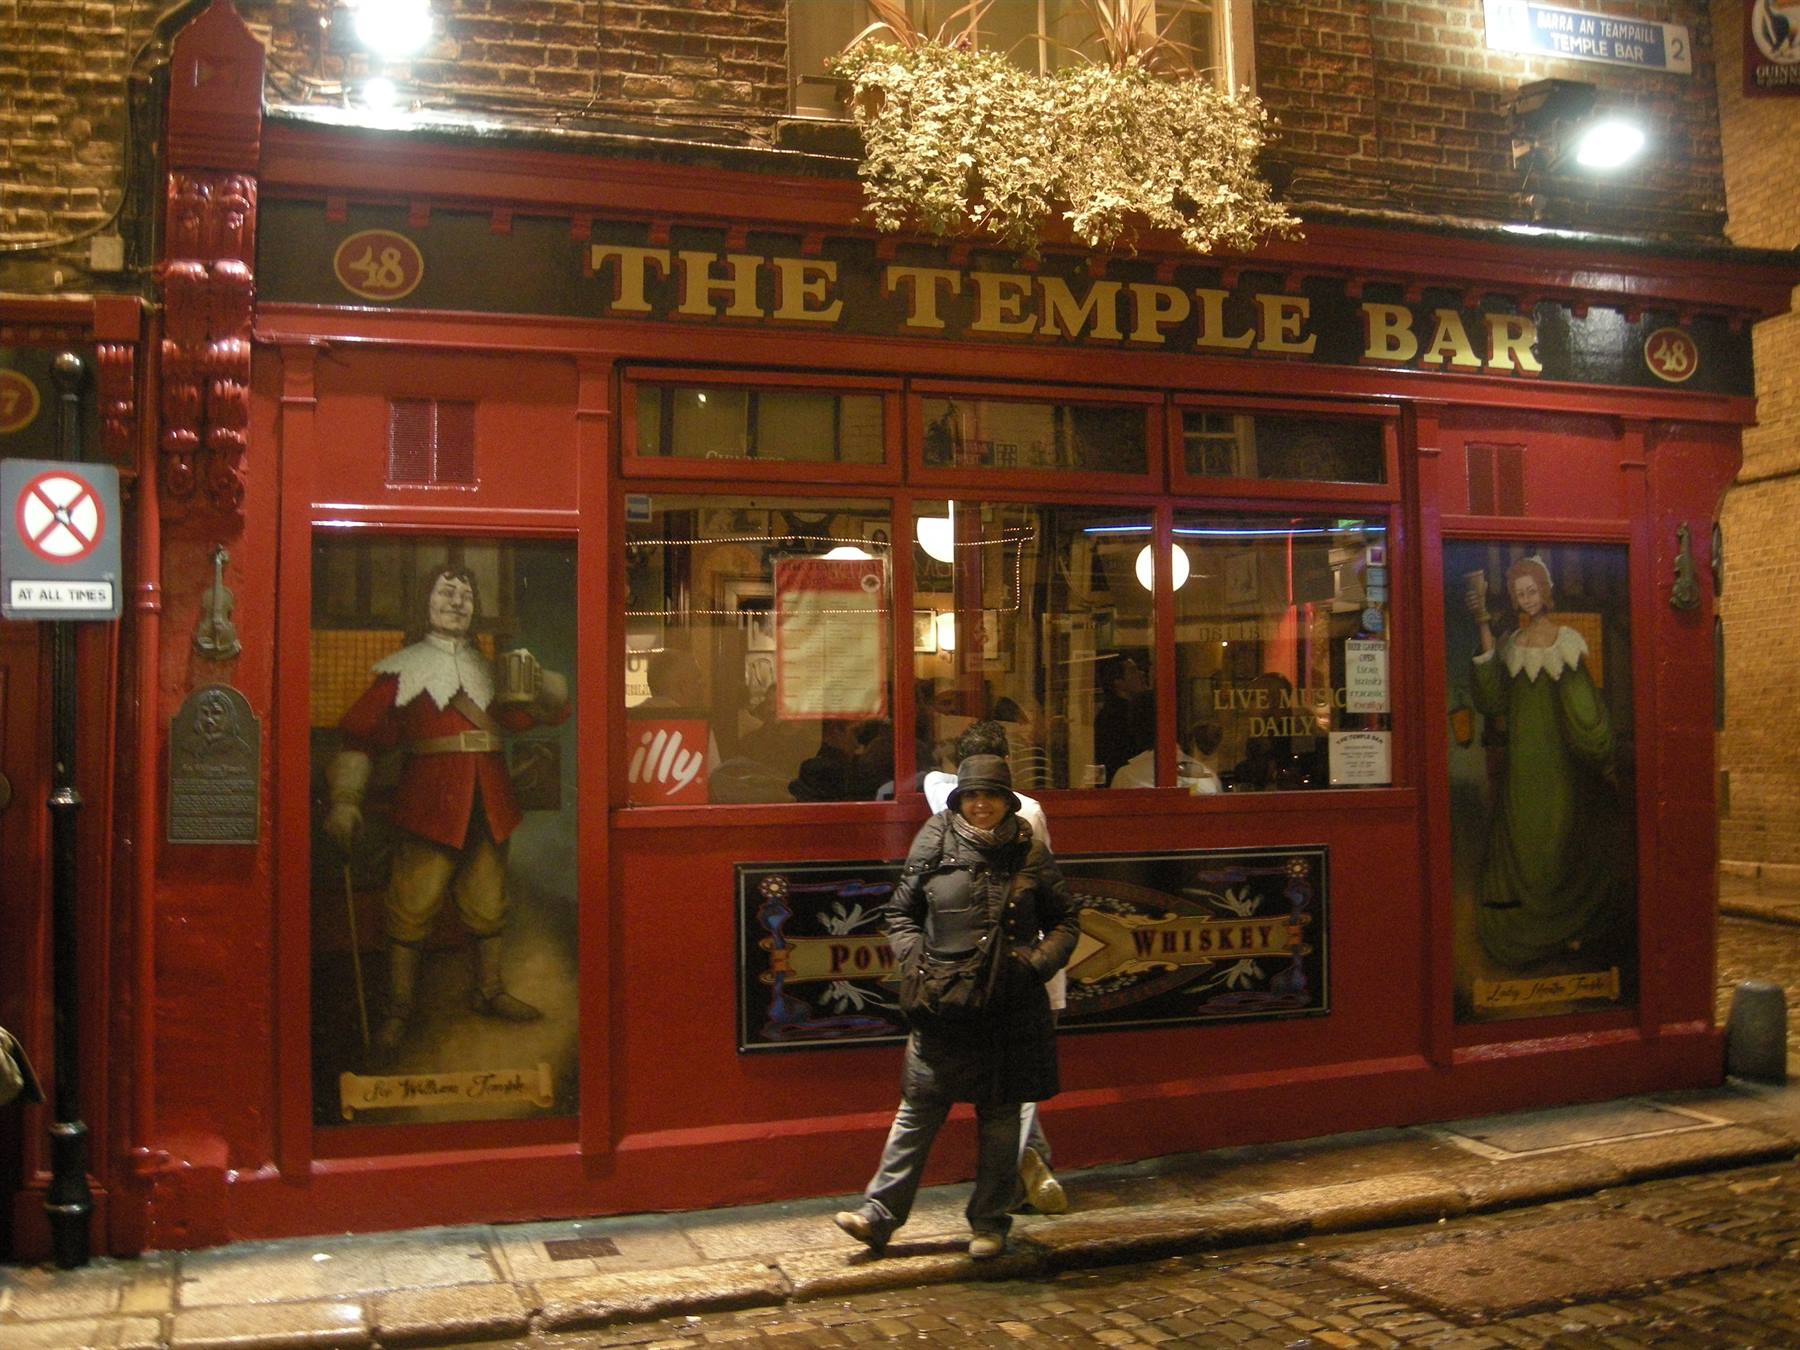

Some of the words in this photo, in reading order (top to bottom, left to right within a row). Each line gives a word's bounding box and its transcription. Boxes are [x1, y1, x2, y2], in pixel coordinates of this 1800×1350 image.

[1579, 19, 1595, 36] AN
[1599, 20, 1655, 44] TEAMPAILL
[1550, 33, 1609, 58] TEMPLE
[1614, 42, 1645, 63] BAR
[1671, 38, 1685, 61] 2
[349, 245, 405, 289] 48
[590, 243, 845, 323] THE
[887, 265, 1318, 354] TEMPLE
[1361, 302, 1543, 373] BAR
[1653, 337, 1689, 373] 48
[18, 586, 34, 601] AT
[40, 586, 63, 601] ALL
[68, 586, 107, 602] TIMES
[1213, 687, 1271, 711] LIVE
[1279, 687, 1346, 710] MUSIC
[1249, 716, 1316, 737] DAILY
[628, 728, 703, 796] illy
[1131, 925, 1273, 958] WHISKEY
[399, 1077, 459, 1098] William
[466, 1073, 525, 1098] Temple
